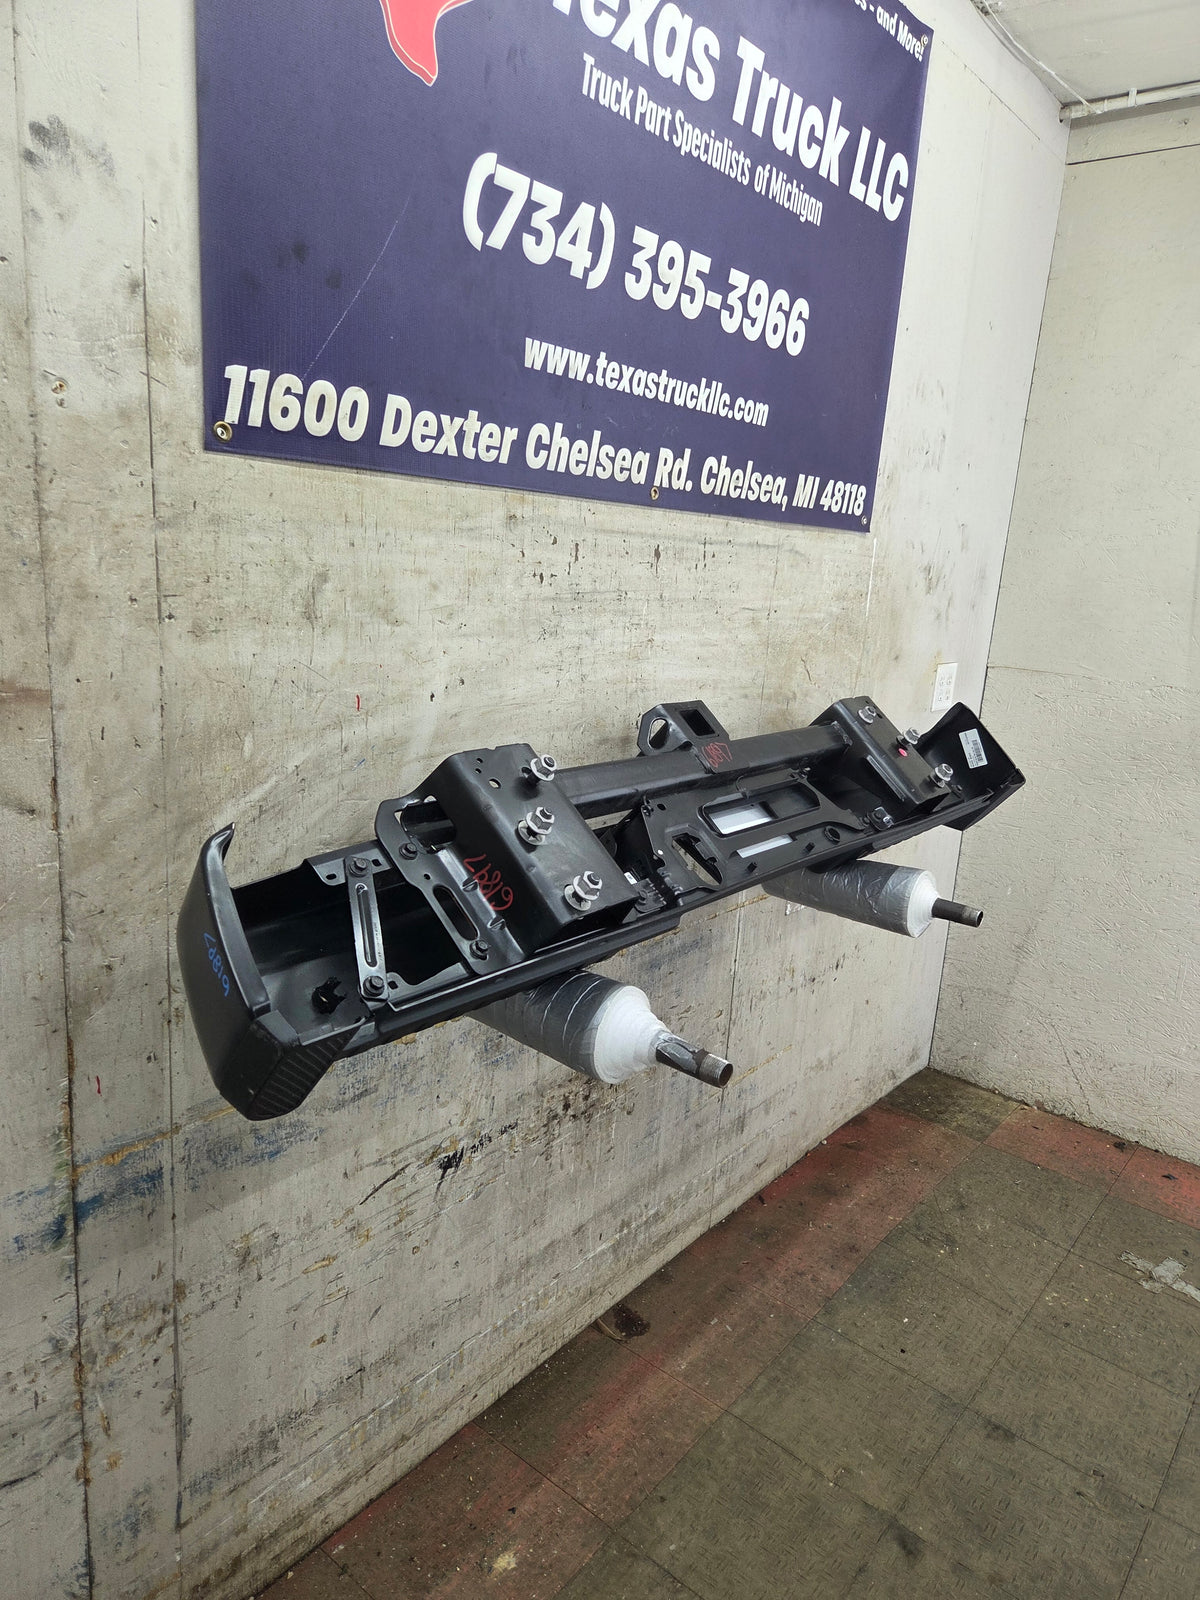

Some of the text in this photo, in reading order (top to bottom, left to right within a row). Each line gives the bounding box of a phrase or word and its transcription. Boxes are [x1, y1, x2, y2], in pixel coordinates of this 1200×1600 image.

[552, 0, 909, 222] exas Truck LLC
[876, 5, 898, 37] and
[896, 19, 925, 62] More!
[581, 52, 823, 227] Truck Part Specialists of Michigan
[462, 151, 810, 357] (734) 395-3966
[223, 364, 867, 517] 11600 Dexter Chelsea Rd. Chelsea, MI 48118
[524, 337, 769, 427] www.texastruckllc.com
